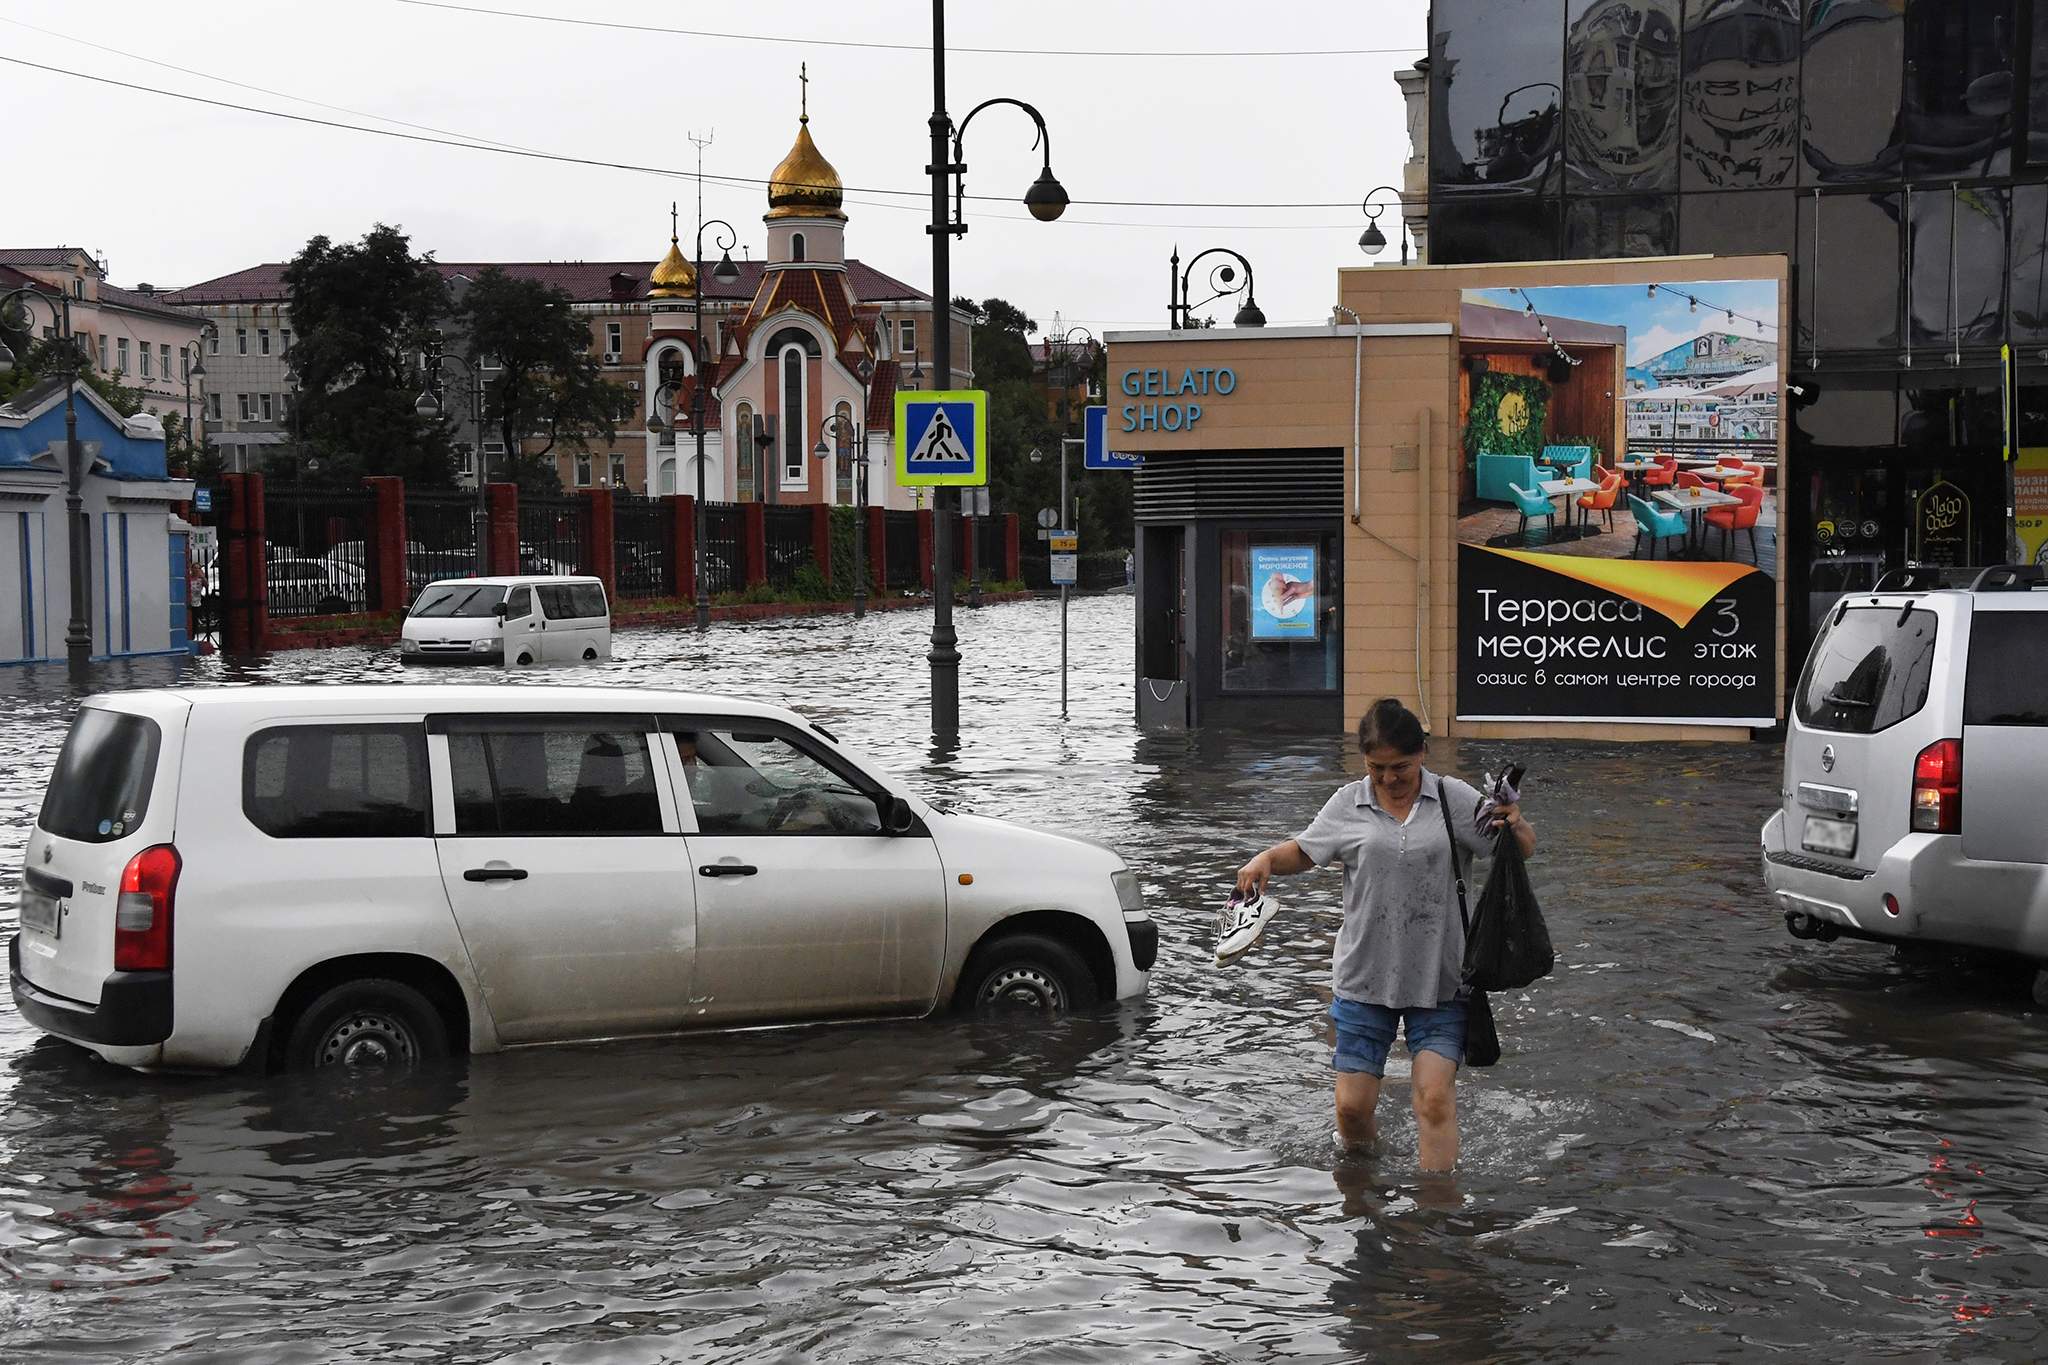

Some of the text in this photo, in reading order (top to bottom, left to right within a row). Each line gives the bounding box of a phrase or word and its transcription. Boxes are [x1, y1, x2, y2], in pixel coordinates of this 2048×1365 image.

[1121, 367, 1236, 397] GELATO
[1121, 403, 1202, 433] SHOP
[1477, 589, 1642, 627] Терраса
[1711, 599, 1740, 638] 3
[1478, 635, 1667, 665] меджелис
[1694, 643, 1757, 659] этаж
[1476, 669, 1756, 689] оазис в самом центре города
